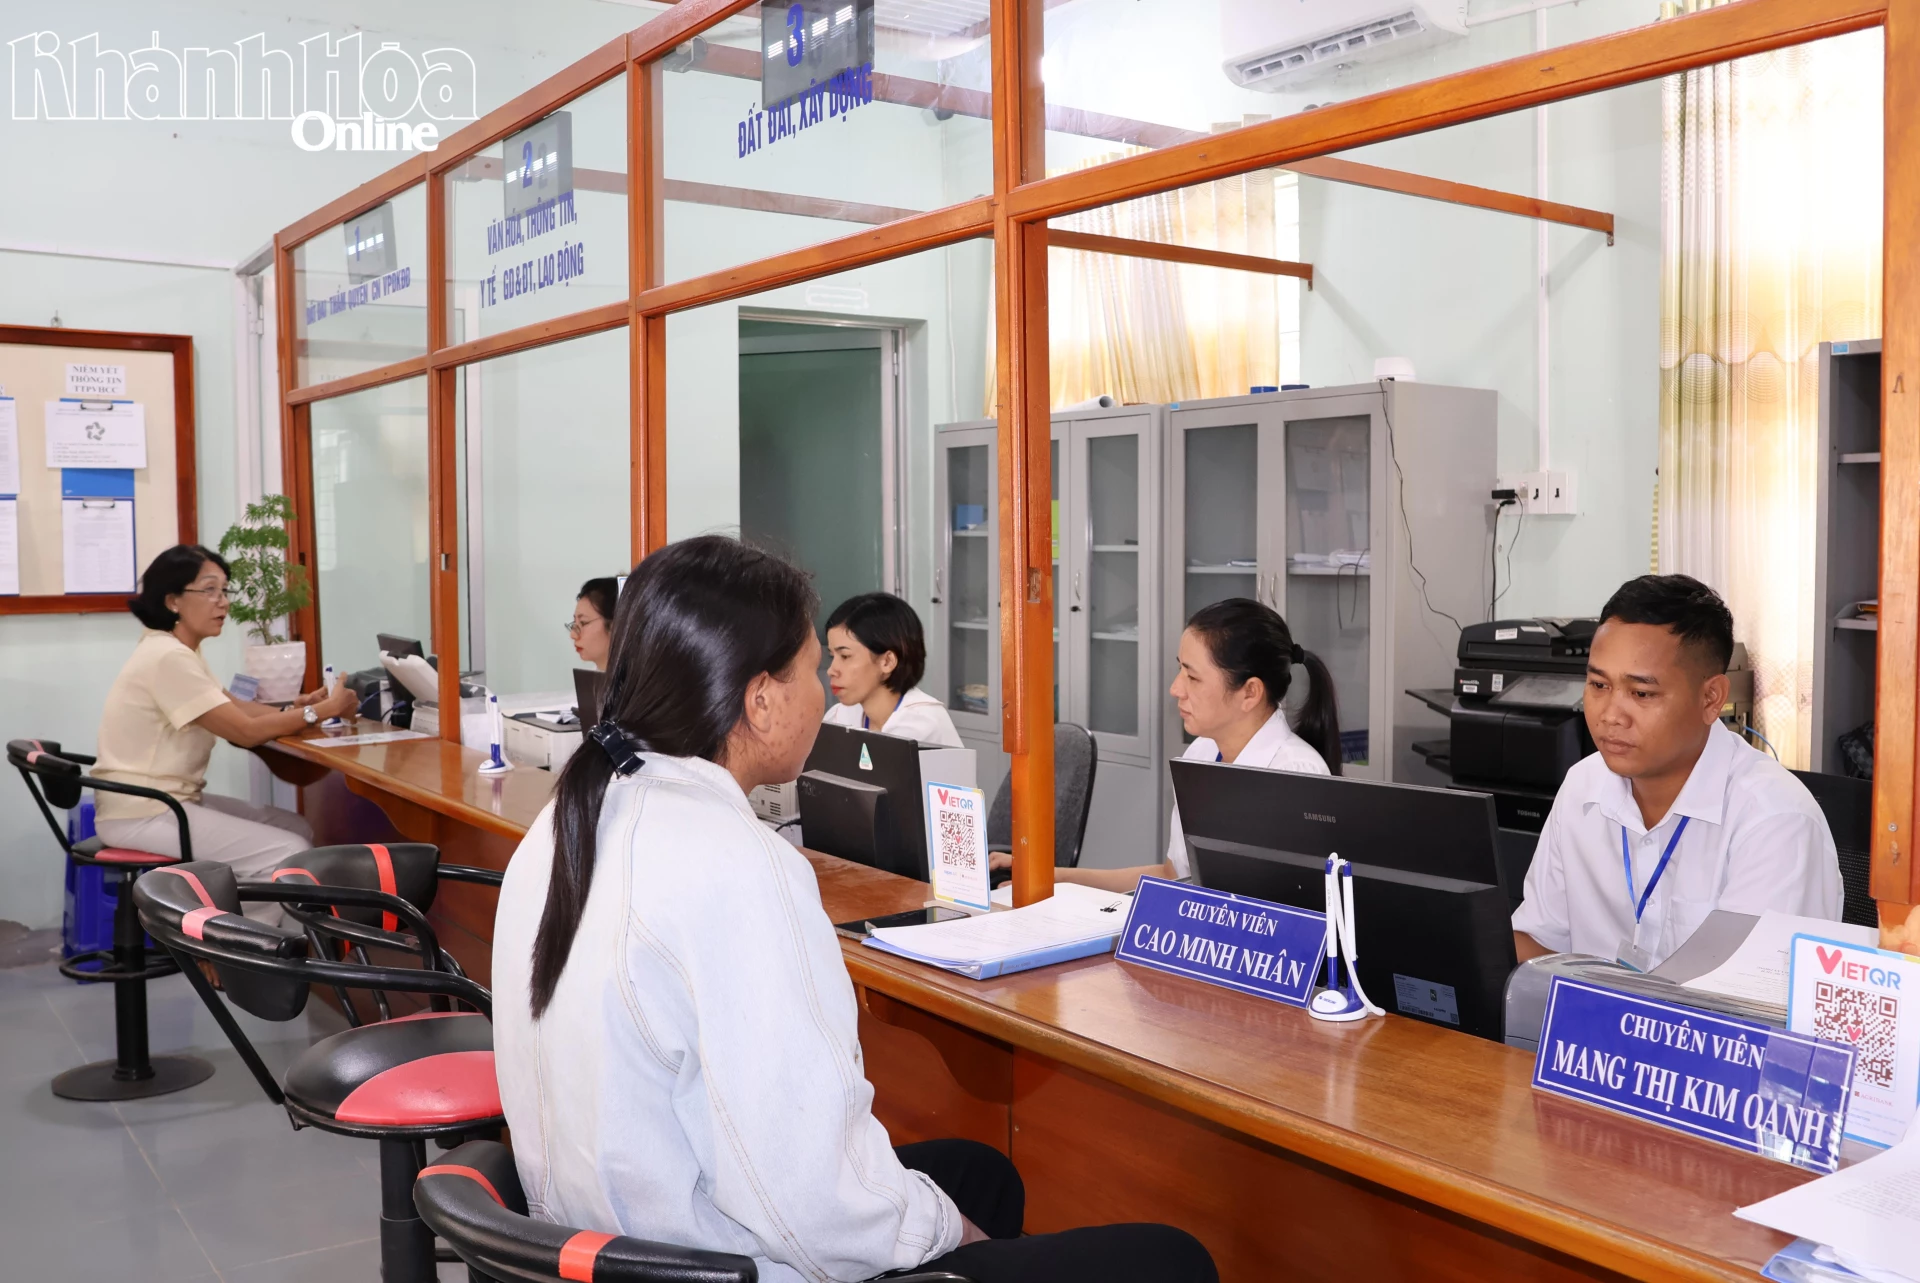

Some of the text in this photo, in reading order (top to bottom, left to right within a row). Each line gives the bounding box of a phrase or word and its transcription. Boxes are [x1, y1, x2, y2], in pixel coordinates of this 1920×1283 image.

[786, 3, 804, 67] 3
[738, 102, 763, 159] ĐẤT
[767, 97, 796, 144] ĐAI,
[798, 78, 826, 131] XÂY
[522, 140, 533, 189] 2
[354, 225, 360, 262] 1
[487, 218, 504, 256] VĂN
[525, 196, 556, 240] THÔNG
[480, 279, 486, 309] Y
[486, 264, 497, 307] TẾ
[537, 252, 555, 289] LAO
[557, 241, 585, 287] ĐỘNG
[70, 375, 104, 383] THÔNG
[1303, 812, 1337, 824] SAMSUNG
[1516, 809, 1541, 818] TOSHIBA
[1178, 899, 1279, 937] CHUYÊN VIÊN
[1133, 923, 1177, 955] CAO
[1176, 933, 1239, 971] MINH
[1236, 948, 1306, 989] NHÂN
[1620, 1012, 1766, 1071] CHUYÊN VIÊN
[1551, 1039, 1627, 1090] MANG
[1632, 1061, 1680, 1112] THỊ
[1680, 1075, 1740, 1123] KIM
[1743, 1093, 1828, 1149] OANH
